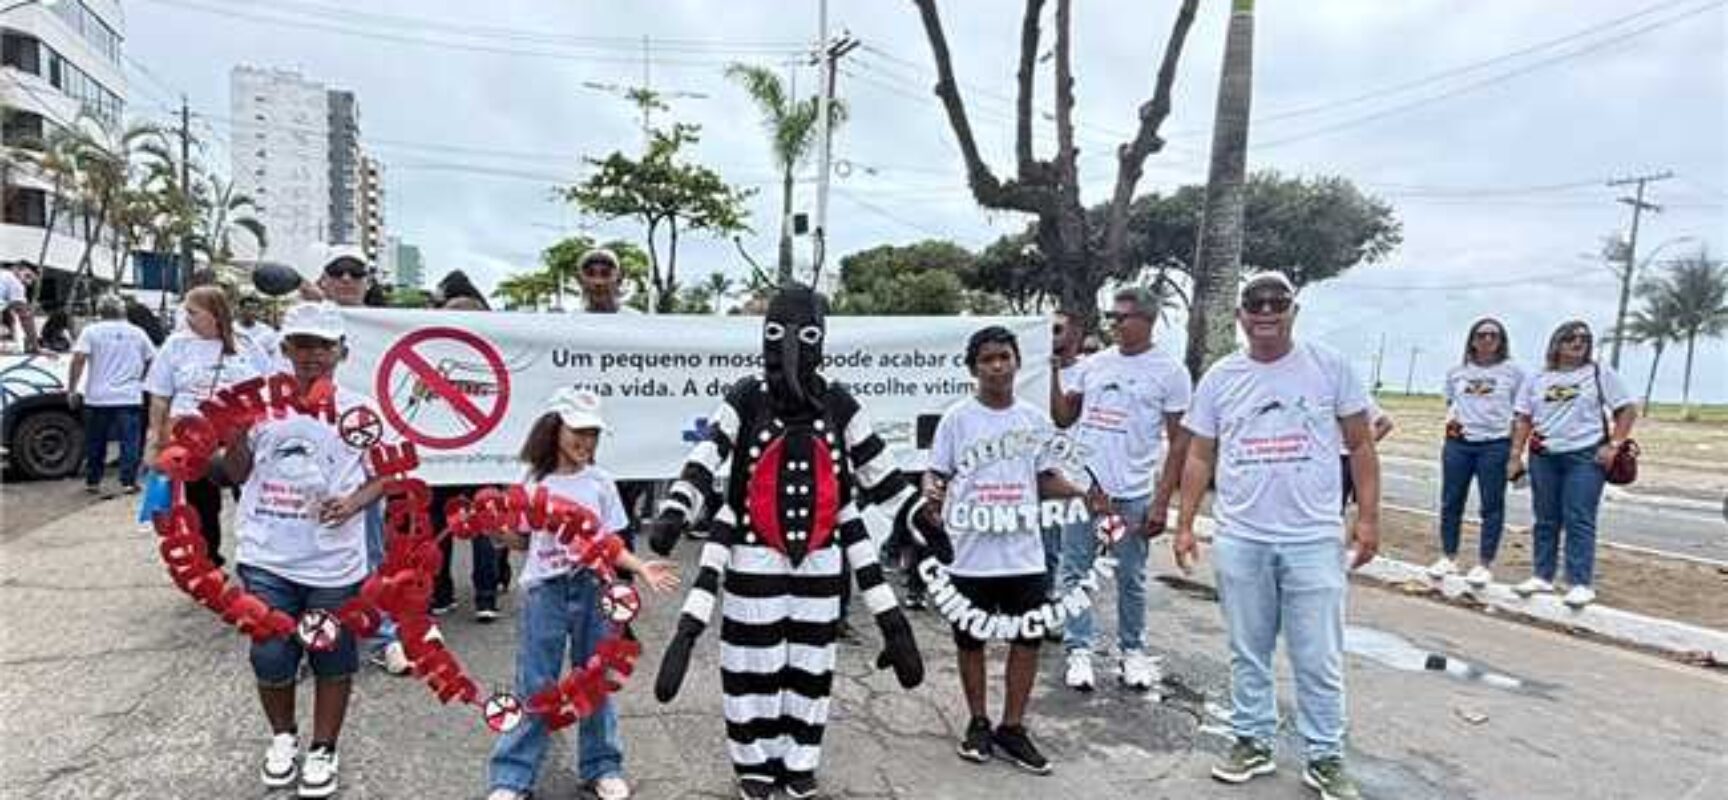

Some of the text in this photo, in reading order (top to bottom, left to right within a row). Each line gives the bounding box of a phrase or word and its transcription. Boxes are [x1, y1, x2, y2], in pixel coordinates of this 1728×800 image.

[552, 349, 593, 368] Um
[601, 352, 702, 373] pequeno
[821, 349, 874, 371] pode
[879, 350, 947, 368] acabar
[619, 377, 676, 397] vida.
[682, 379, 699, 396] A
[850, 377, 918, 395] scolhe
[950, 498, 1090, 533] CONTRA
